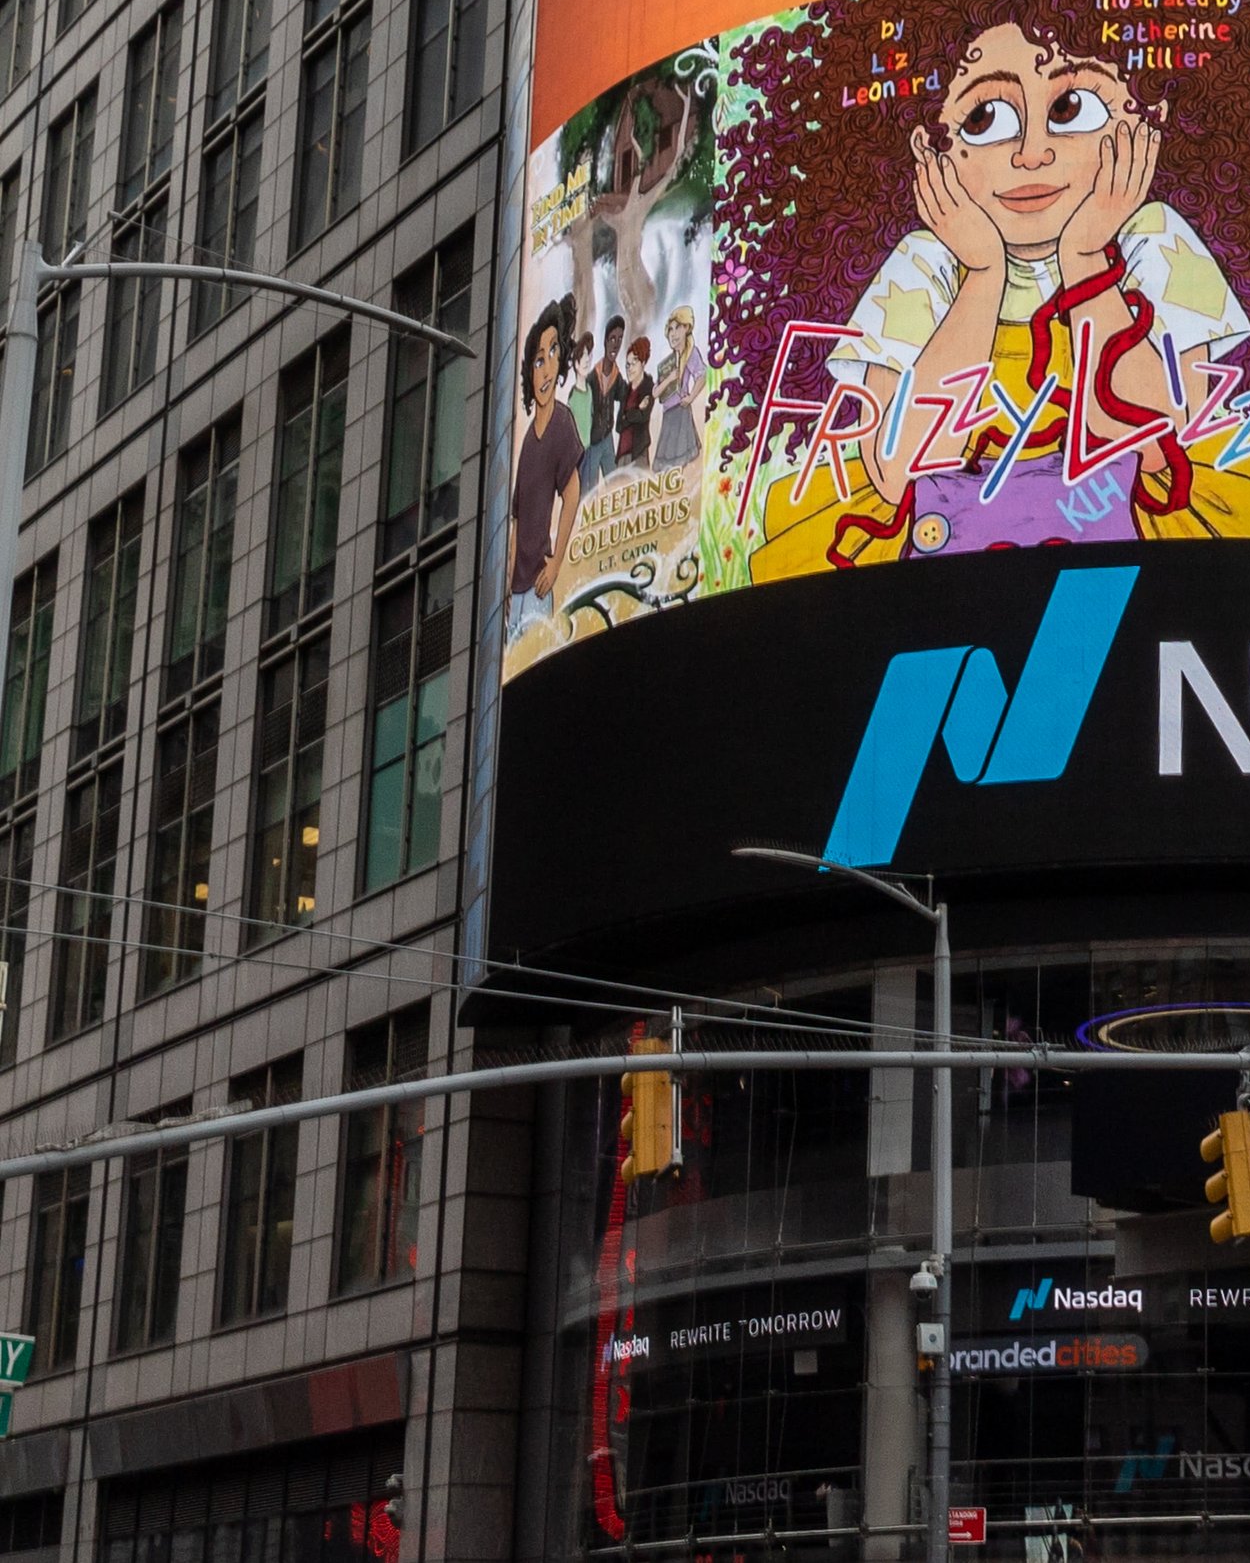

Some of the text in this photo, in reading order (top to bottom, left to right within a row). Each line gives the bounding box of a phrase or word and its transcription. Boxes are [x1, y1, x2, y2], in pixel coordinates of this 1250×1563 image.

[881, 19, 905, 41] by
[1101, 20, 1231, 45] Katherine
[871, 49, 909, 75] Liz
[1126, 47, 1212, 71] Hillier
[842, 69, 941, 108] Leonard
[578, 466, 685, 532] MEETING
[567, 496, 691, 565] COLUMBUS
[621, 541, 658, 565] CATON
[1054, 1285, 1143, 1313] Nasdaq
[613, 1333, 649, 1363] Nasdaq
[670, 1321, 732, 1350] REWRITE
[0, 1340, 26, 1378] Y
